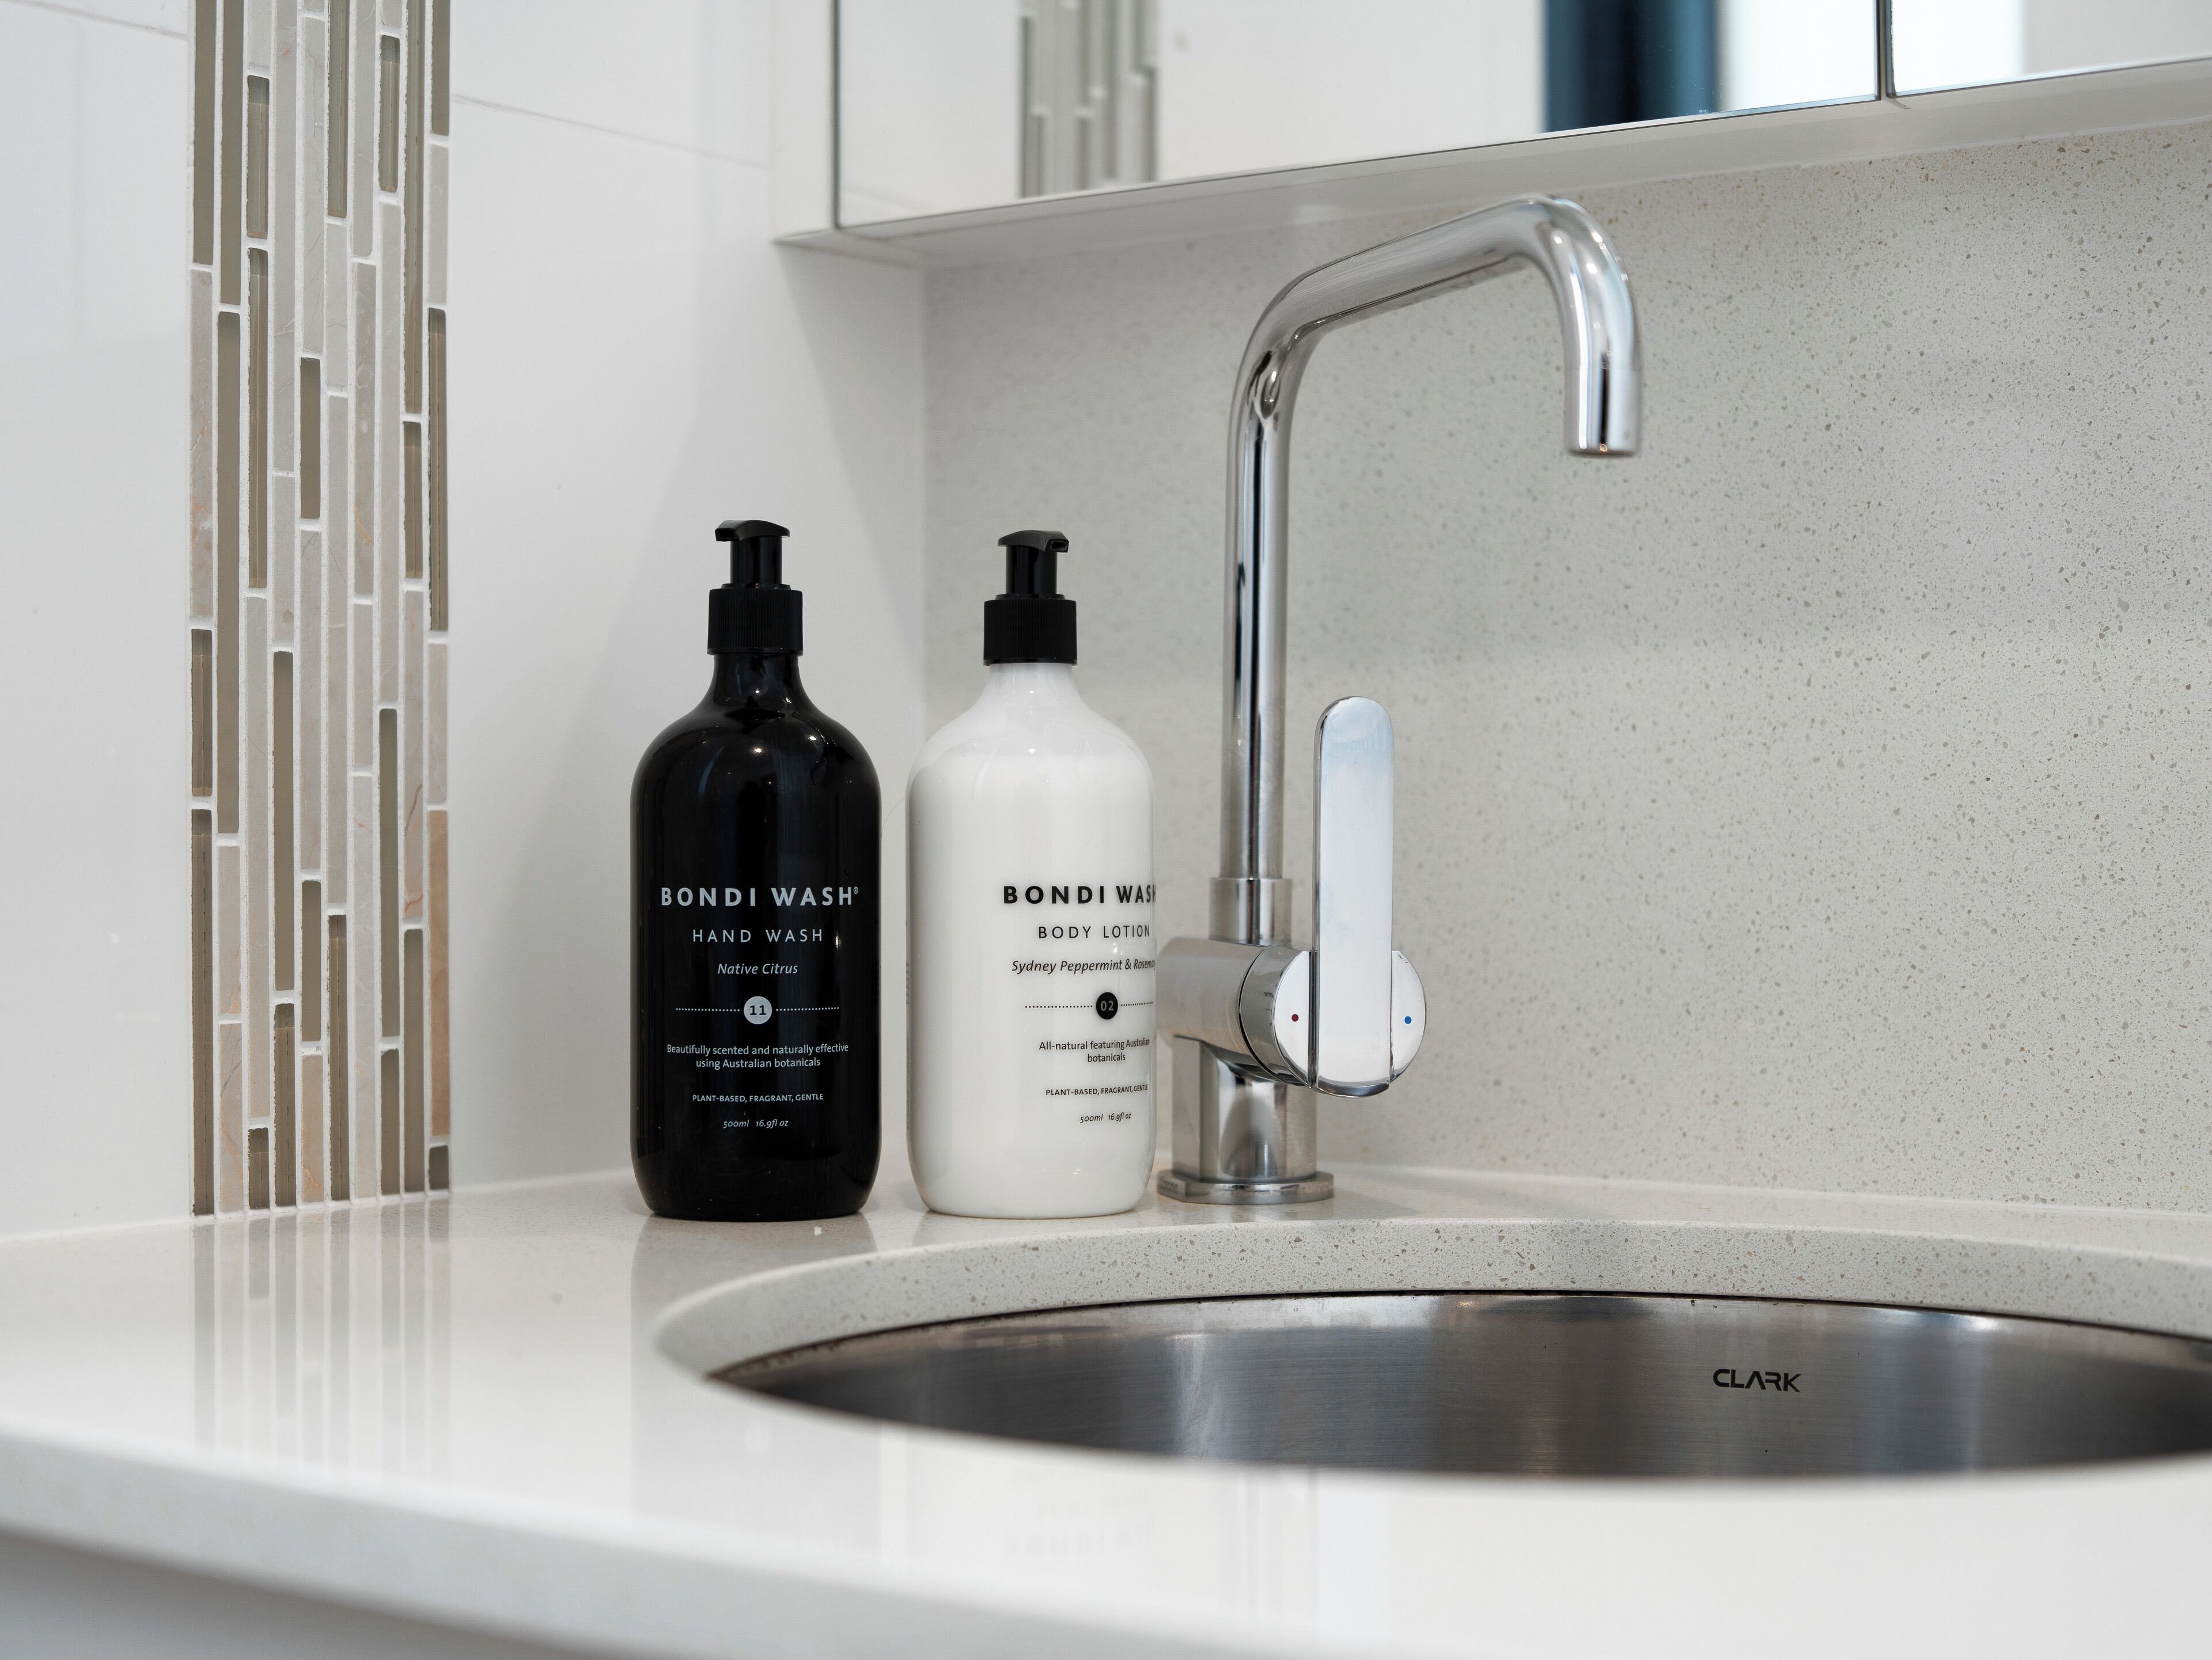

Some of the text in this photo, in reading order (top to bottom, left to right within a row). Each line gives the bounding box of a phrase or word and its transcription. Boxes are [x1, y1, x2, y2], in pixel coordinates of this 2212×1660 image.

[661, 887, 756, 907] BONDI
[1003, 885, 1104, 904] BONDI
[693, 928, 822, 943] HAND WASH
[1038, 924, 1150, 939] BODY LOTION
[717, 963, 798, 975] Native Citrus
[1012, 958, 1156, 975] Sydney Peppermint & Rosema
[749, 1005, 767, 1015] 11
[1100, 1000, 1114, 1011] 02
[667, 1043, 849, 1057] Beautifully scented and naturally effective
[1039, 1037, 1150, 1051] All-natural featuring Australian
[696, 1057, 821, 1070] using Australian botanicals
[1087, 1052, 1126, 1063] botanicals
[1046, 1083, 1148, 1096] PLANT-BASED, FRAGRANT, GENTLE
[692, 1094, 747, 1104] PLANT-BASED,
[723, 1119, 749, 1129] 500ml
[756, 1119, 778, 1129] 16.9fl
[1080, 1113, 1104, 1124] 500ml
[1108, 1112, 1124, 1122] 16.9fl
[1713, 1369, 1802, 1393] CLARK
